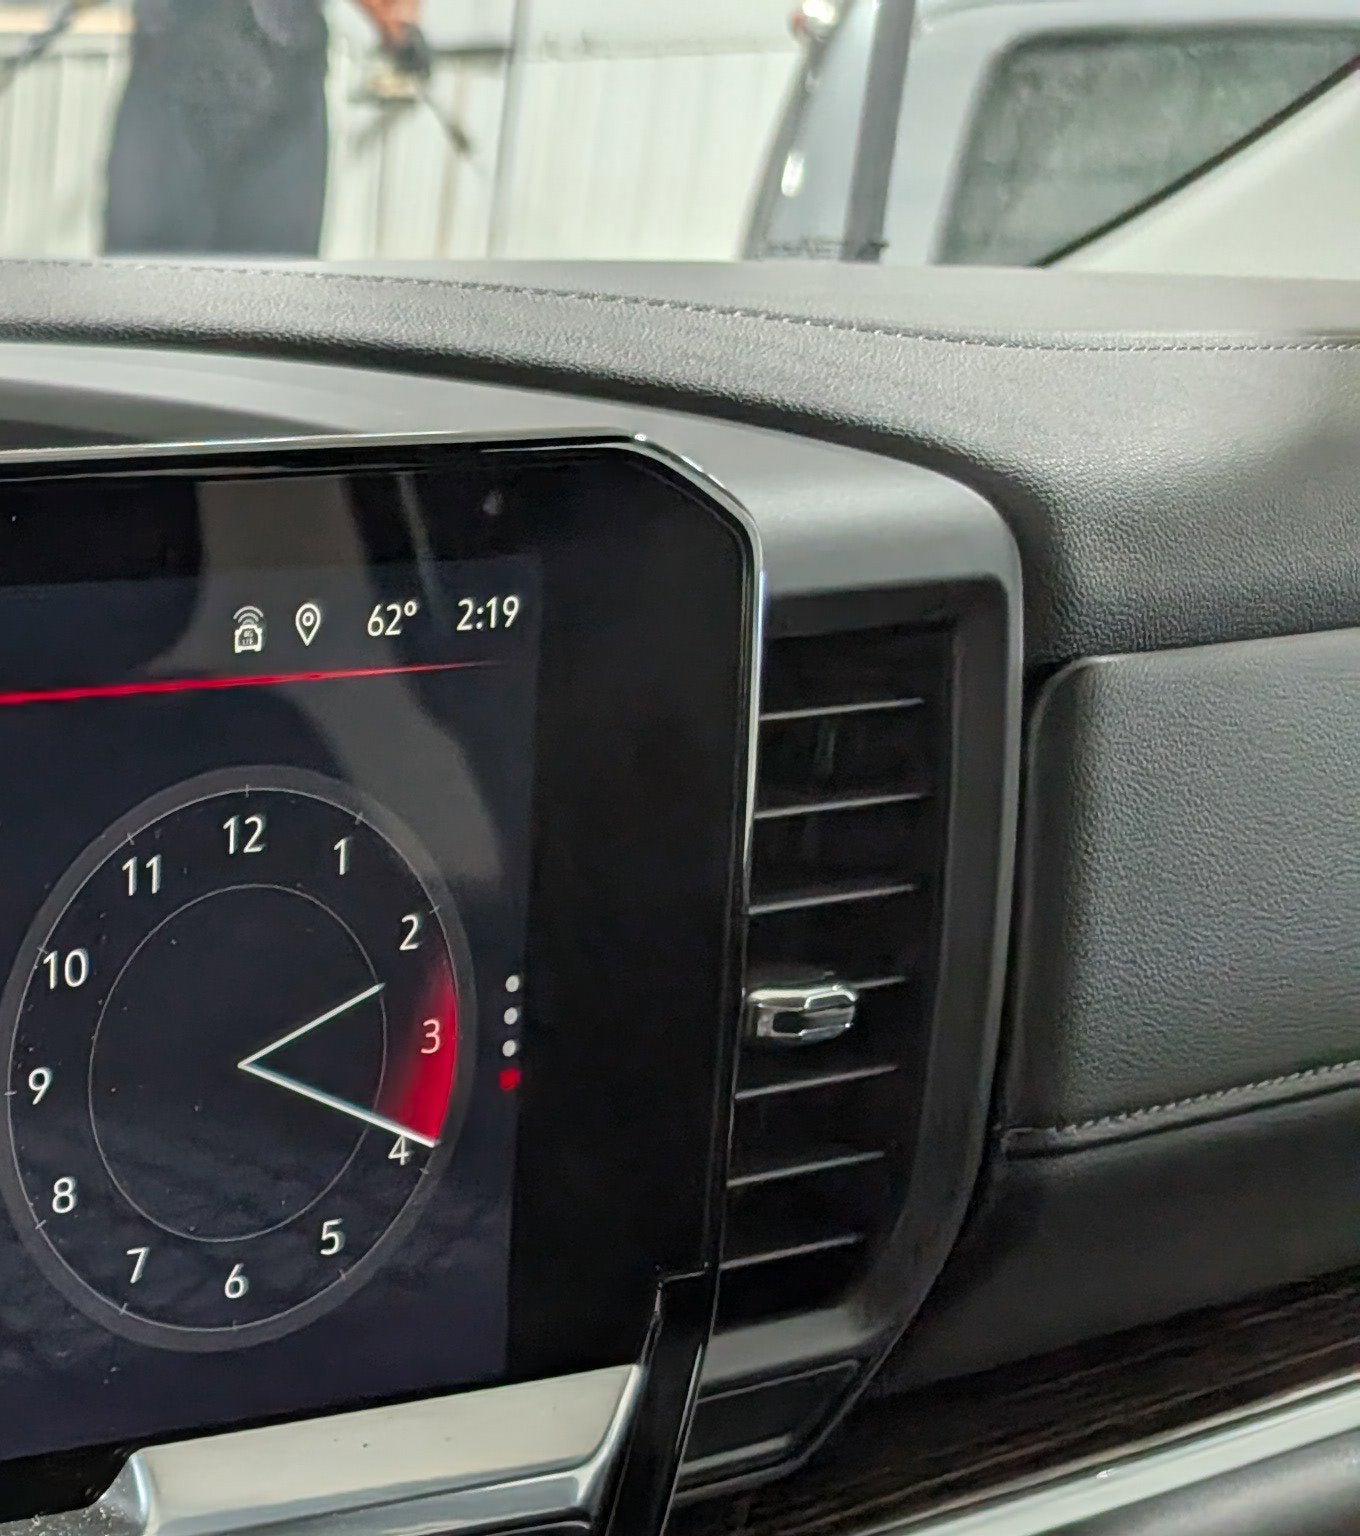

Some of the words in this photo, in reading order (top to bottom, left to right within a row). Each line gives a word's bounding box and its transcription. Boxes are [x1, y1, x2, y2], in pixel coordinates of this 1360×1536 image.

[456, 595, 520, 631] 2:19
[223, 814, 266, 855] 12
[122, 855, 162, 896] 11
[333, 838, 350, 876] 1
[399, 914, 421, 951] 2
[43, 948, 88, 989] 10
[420, 1018, 442, 1054] 3
[27, 1068, 52, 1105] 9
[388, 1134, 411, 1166] 4
[52, 1176, 76, 1214] 8
[319, 1218, 345, 1256] 5
[126, 1248, 149, 1284] 7
[223, 1264, 248, 1299] 6
